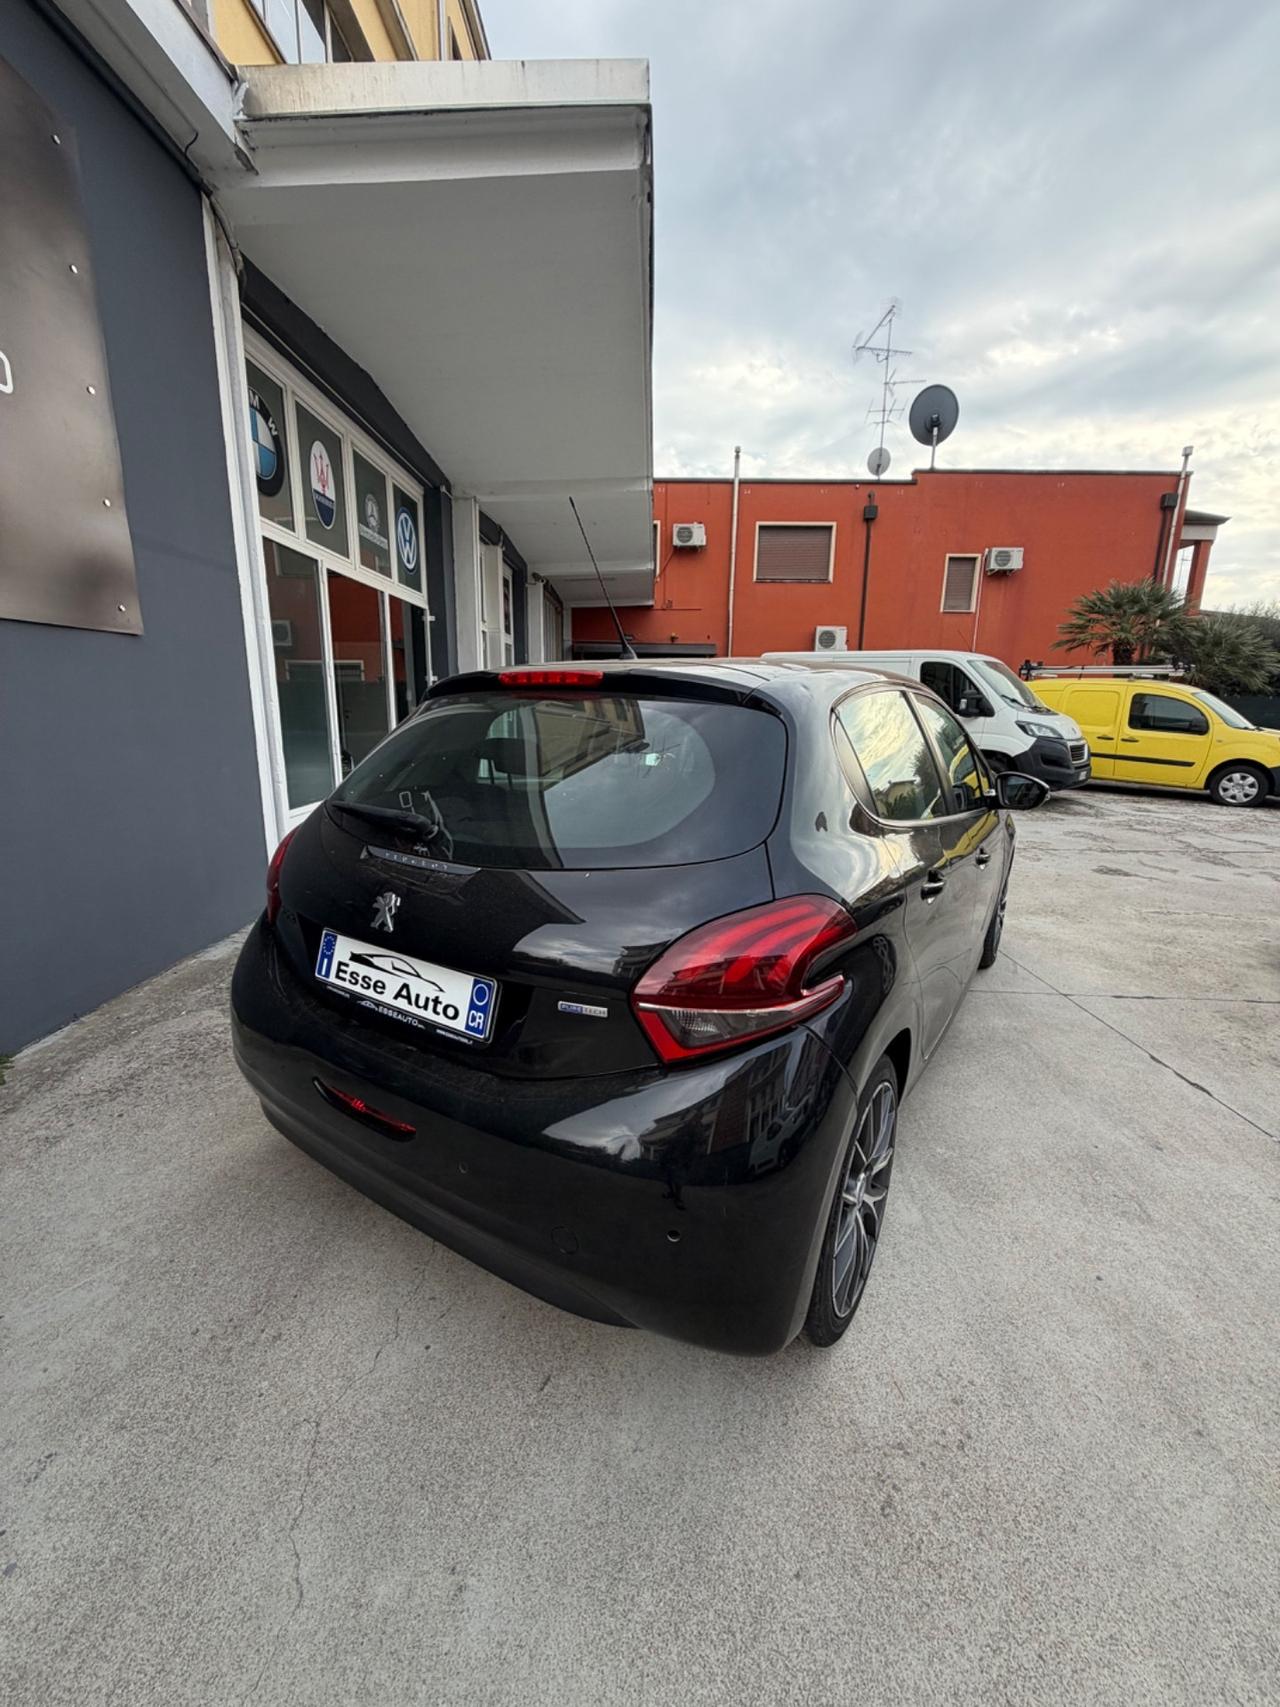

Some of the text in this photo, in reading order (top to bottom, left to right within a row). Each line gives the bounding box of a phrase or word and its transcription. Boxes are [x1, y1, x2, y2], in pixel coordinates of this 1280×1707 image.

[334, 960, 460, 1021] Esse Auto
[468, 1010, 483, 1030] CR
